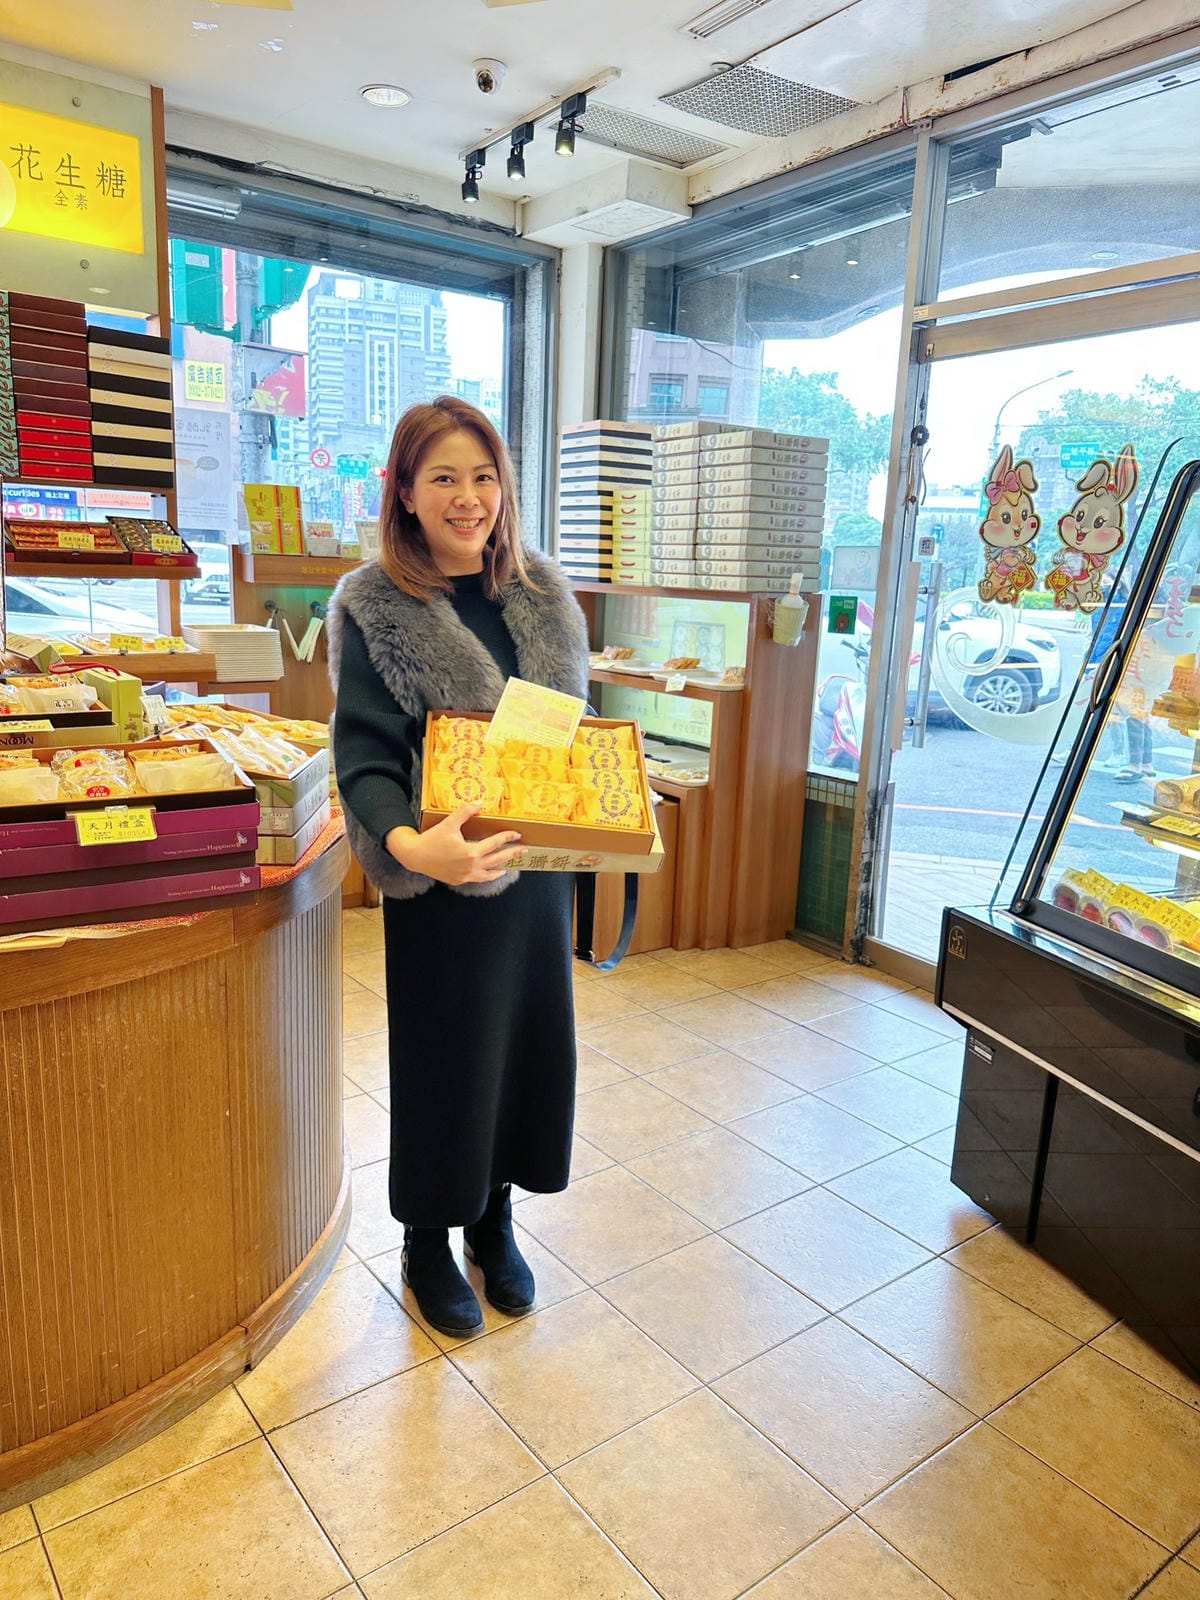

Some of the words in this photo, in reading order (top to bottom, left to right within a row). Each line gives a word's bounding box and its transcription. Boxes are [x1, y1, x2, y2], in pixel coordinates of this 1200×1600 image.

[9, 142, 128, 199] 花生糖
[54, 188, 89, 211] 全素
[1012, 570, 1026, 584] 福
